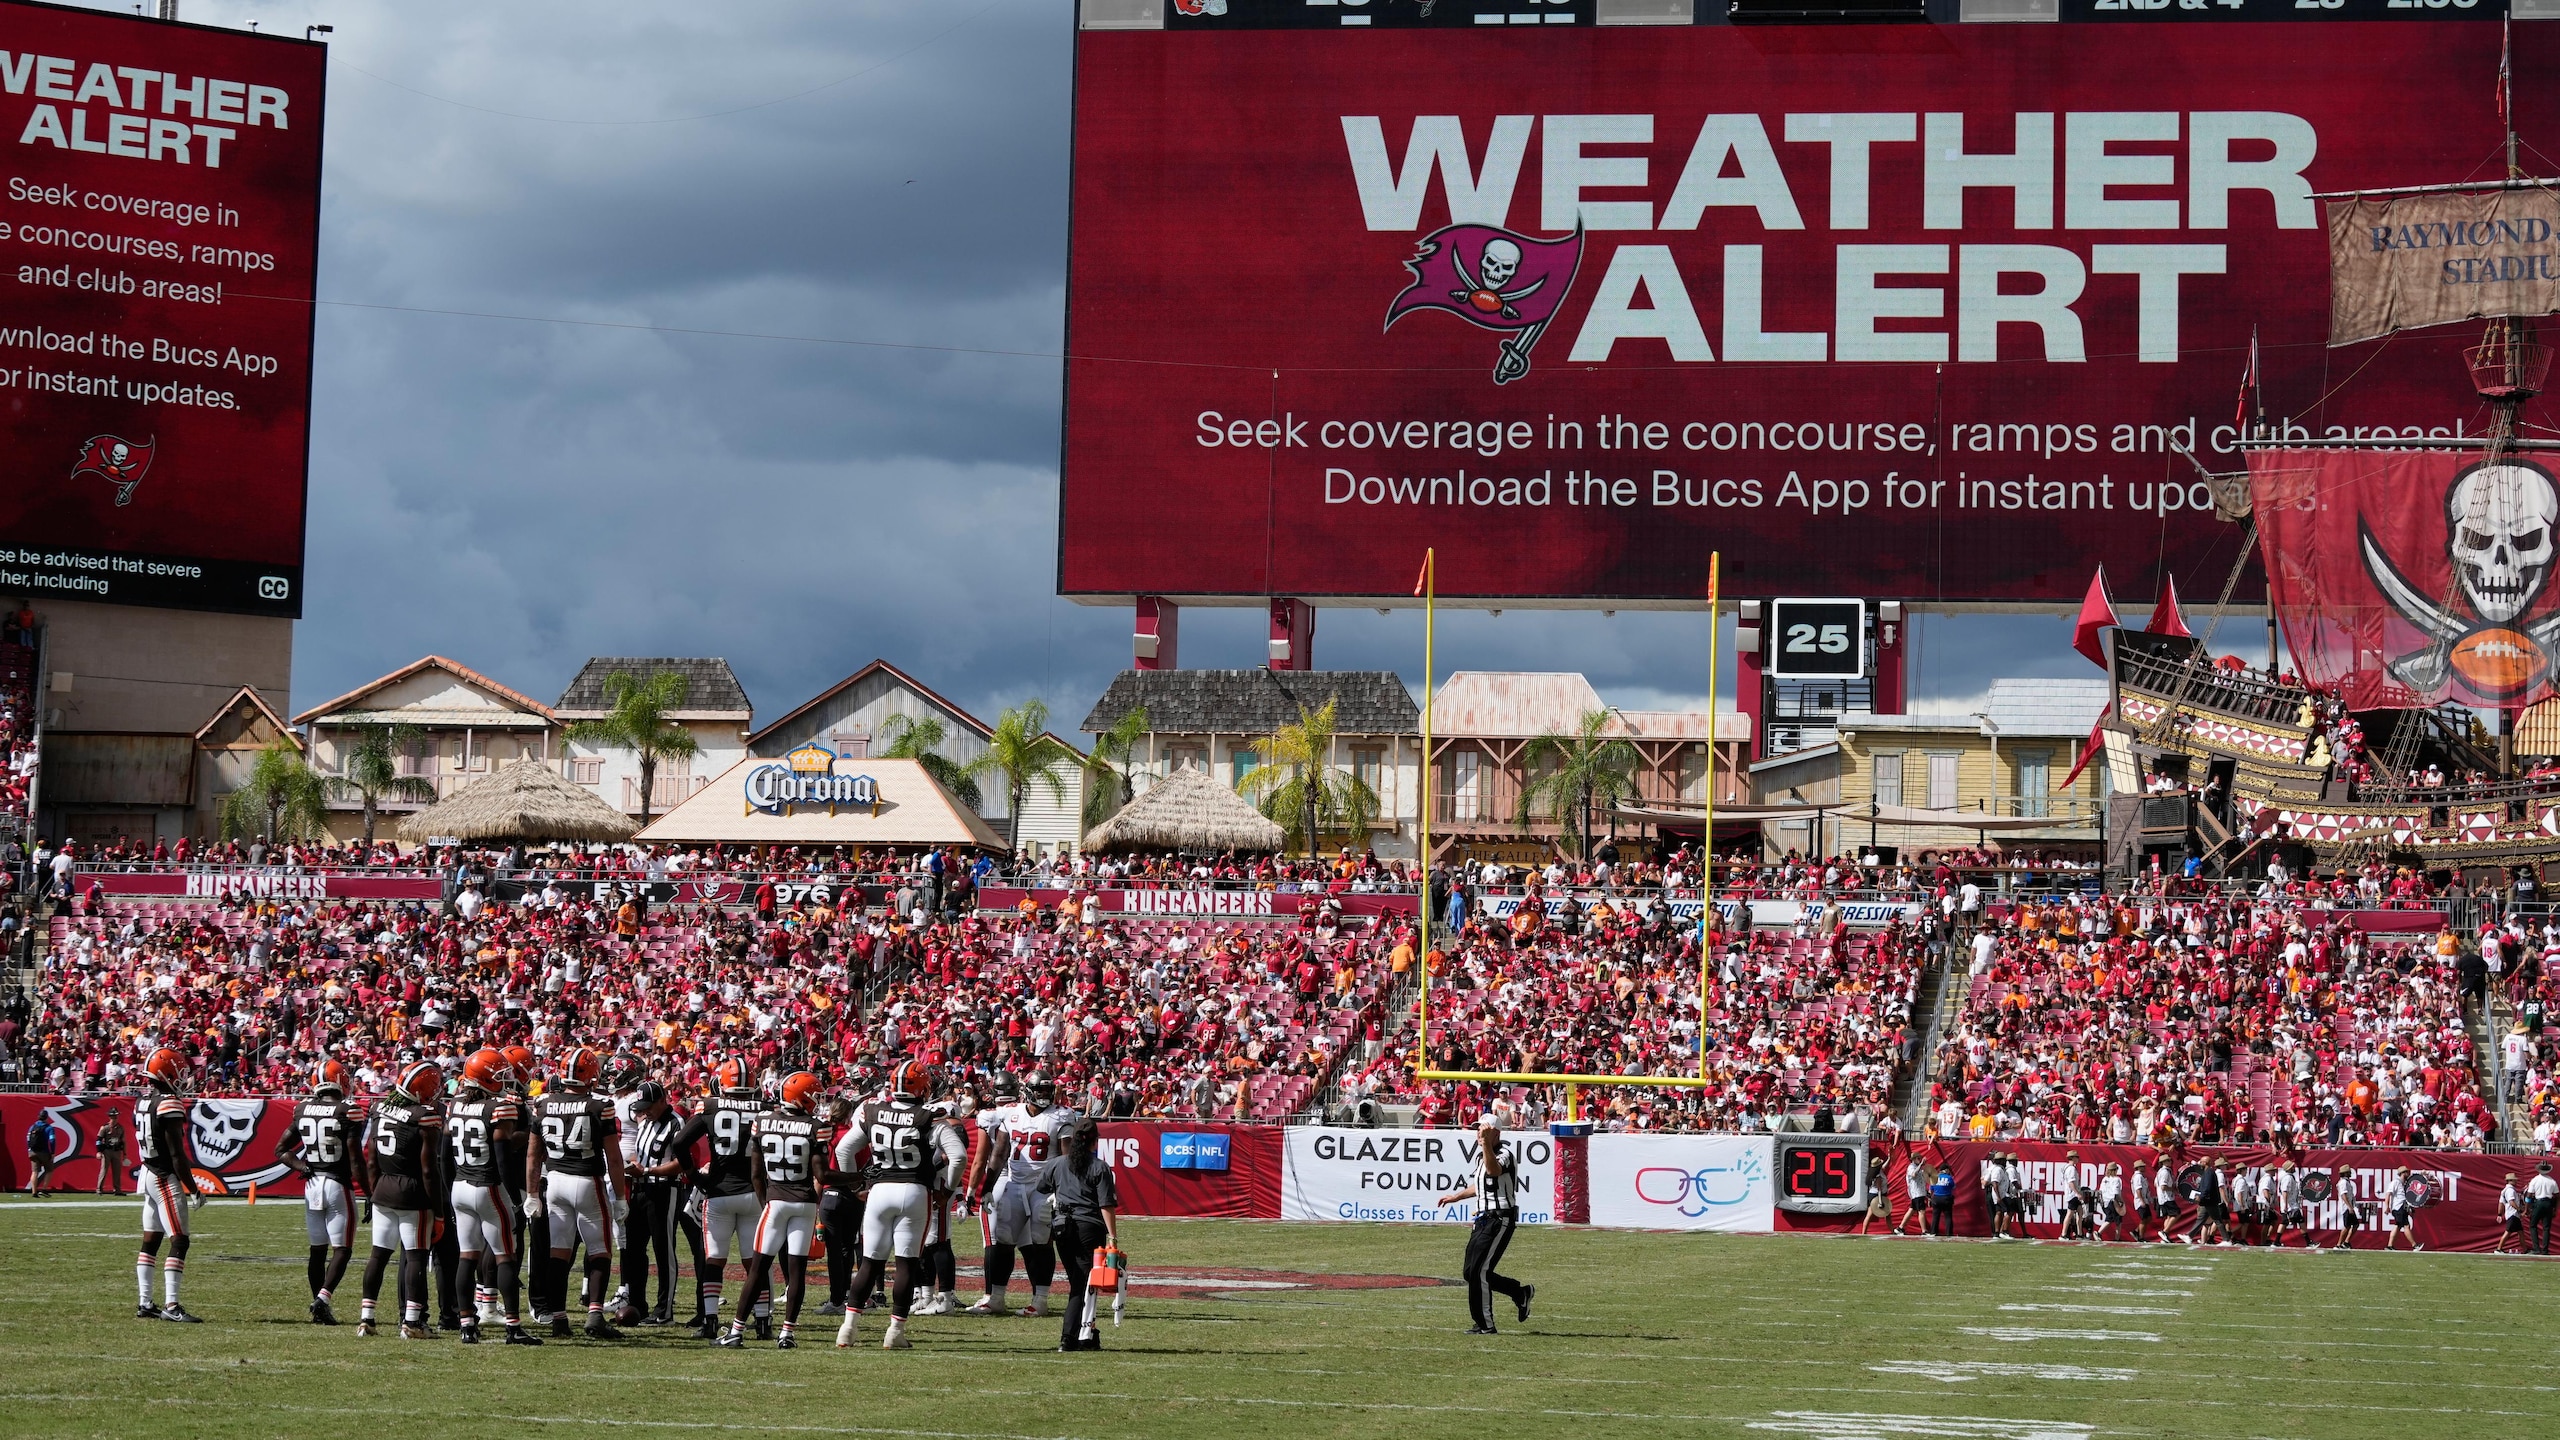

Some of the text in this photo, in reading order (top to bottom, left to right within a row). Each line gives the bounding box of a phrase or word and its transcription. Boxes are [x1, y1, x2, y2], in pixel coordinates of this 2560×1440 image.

[0, 50, 289, 130] WEATHER
[19, 104, 236, 168] ALERT
[1341, 111, 2318, 231] WEATHER
[8, 177, 239, 227] Seek coverage in
[2369, 217, 2550, 253] RAYMOND
[19, 224, 184, 263] concourses,
[191, 243, 275, 273] ramps
[2442, 254, 2560, 286] STADIU
[18, 264, 222, 305] and club areas!
[1568, 244, 2227, 362] ALERT
[0, 326, 278, 378] wnload the Bucs App
[28, 365, 119, 399] instant
[127, 380, 241, 411] updates.
[1197, 411, 1308, 448] Seek
[1321, 421, 1532, 456] coverage
[1548, 414, 1582, 448] in
[1597, 414, 1669, 450] the
[1683, 418, 1936, 457] concourse,
[1953, 424, 2097, 454] ramps
[2111, 417, 2195, 454] and
[2211, 416, 2310, 453] club
[1325, 468, 1550, 506] Download
[1565, 470, 1637, 507] the
[1653, 470, 1762, 508] Bucs
[1776, 471, 1869, 516] App
[1883, 471, 1945, 509] for
[1960, 472, 2113, 510] instant
[20, 549, 41, 565] be
[44, 551, 109, 571] advised
[112, 556, 144, 574] that
[147, 562, 201, 578] severe
[34, 573, 109, 594] including
[261, 581, 287, 596] CC
[1786, 624, 1849, 654] 25
[746, 767, 873, 811] Corona
[1500, 849, 1548, 863] GALLEY
[1364, 867, 1376, 879] 99
[1467, 875, 1476, 885] 12
[187, 875, 326, 898] BUCCANEERS
[776, 884, 831, 904] 976
[1124, 890, 1272, 914] BUCCANEERS
[1531, 902, 1540, 911] 13
[1522, 918, 1527, 927] 6
[1925, 920, 1931, 934] 6
[931, 953, 938, 963] 6
[2315, 948, 2320, 958] 6
[1307, 968, 1313, 976] 7
[2020, 965, 2026, 974] 2
[1114, 978, 1121, 987] 3
[2526, 1003, 2539, 1015] 28
[659, 1027, 672, 1038] 55
[1373, 1020, 1380, 1031] 6
[850, 1038, 858, 1048] 7
[1203, 1029, 1216, 1041] 82
[1972, 1045, 1984, 1056] 40
[2510, 1043, 2516, 1053] 6
[2097, 1069, 2104, 1081] 7
[2151, 1089, 2157, 1099] 2
[303, 1104, 337, 1116] HARDEN
[547, 1101, 587, 1115] GRAHAM
[718, 1099, 762, 1112] BARNETT
[1429, 1102, 1440, 1113] 31
[877, 1110, 914, 1126] COLLINS
[1943, 1112, 1955, 1124] 13
[2236, 1111, 2248, 1124] 12
[376, 1115, 399, 1157] 5
[760, 1119, 812, 1136] BLACKMON
[2392, 1131, 2398, 1141] 7
[298, 1117, 343, 1164] 26
[449, 1117, 490, 1167] 33
[871, 1124, 922, 1170] 96
[1011, 1130, 1051, 1162] 78
[1314, 1135, 1444, 1163] GLAZER
[761, 1134, 810, 1182] 29
[1098, 1138, 1140, 1168] N'S
[1172, 1145, 1225, 1157] CBS NFL
[1791, 1151, 1848, 1195] 25
[1361, 1171, 1530, 1194] FOUNDAN
[1338, 1202, 1405, 1222] Glasses
[1412, 1204, 1439, 1221] For
[1447, 1204, 1469, 1222] All
